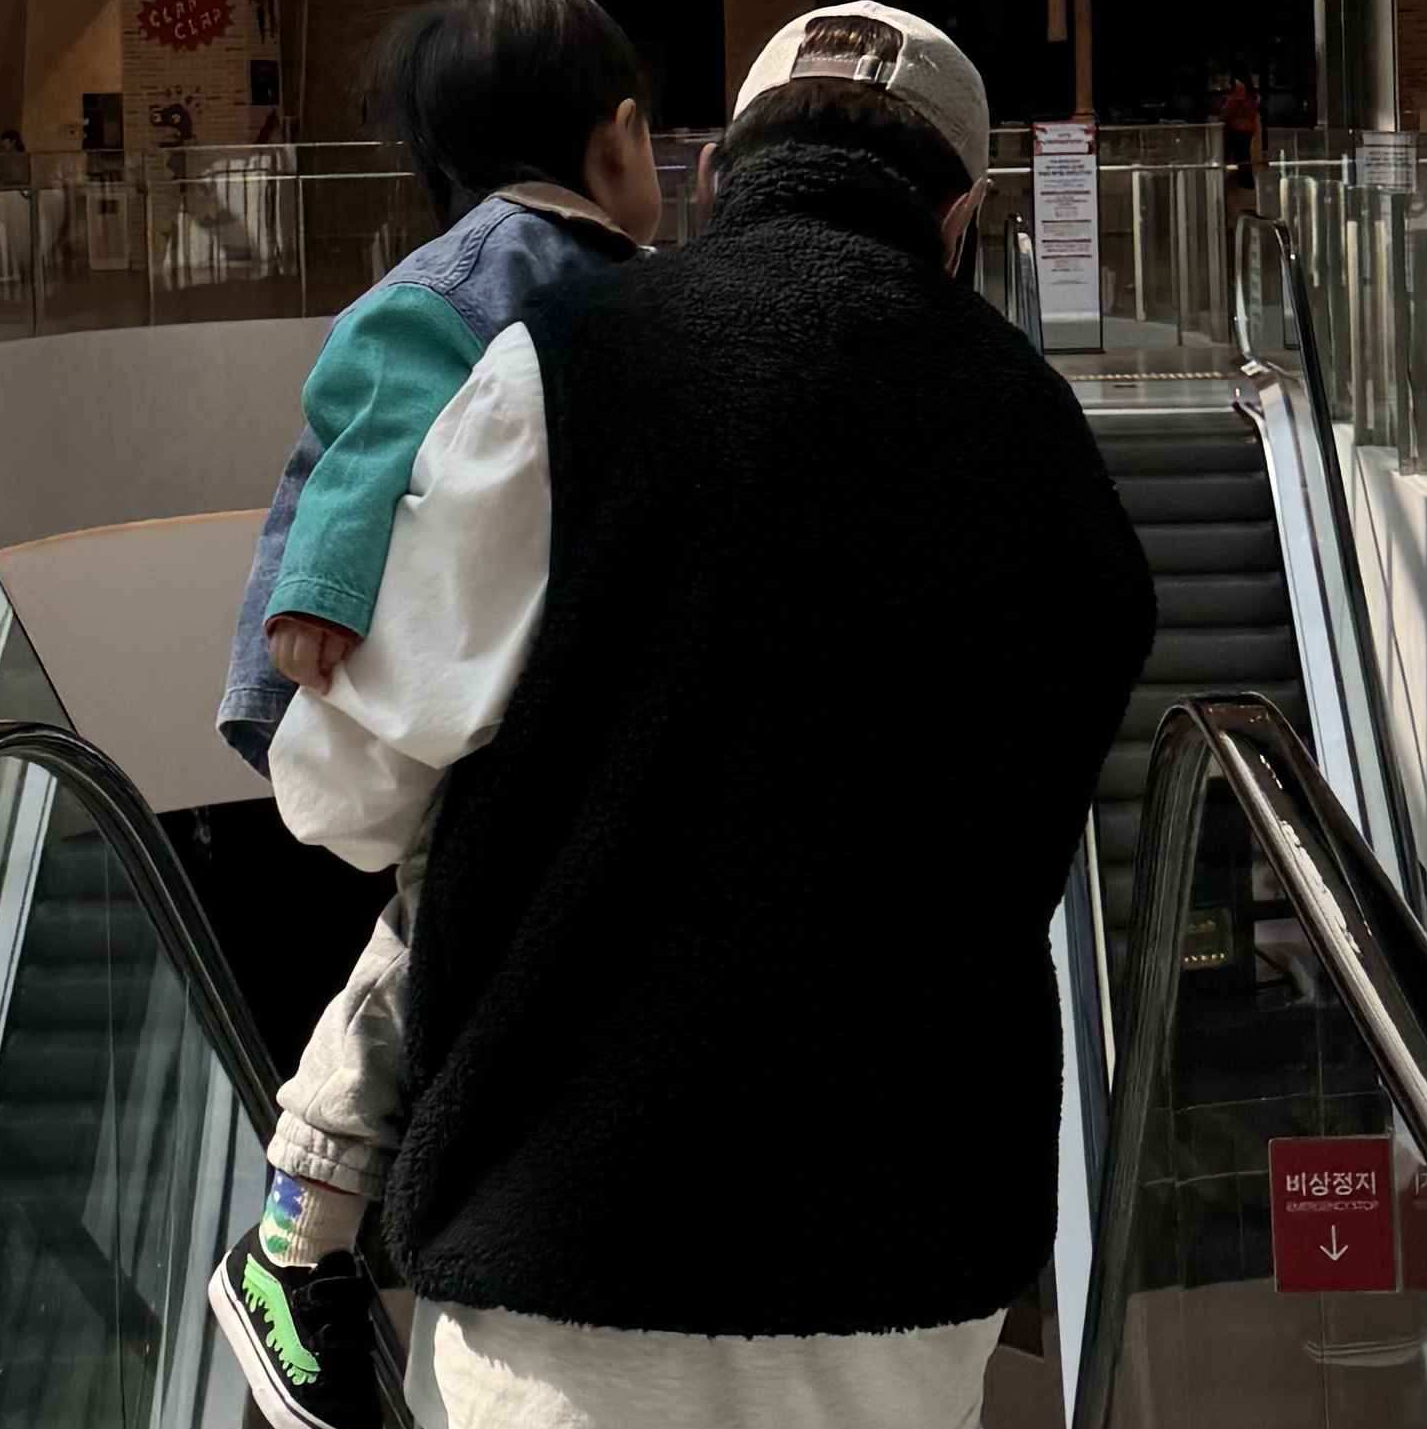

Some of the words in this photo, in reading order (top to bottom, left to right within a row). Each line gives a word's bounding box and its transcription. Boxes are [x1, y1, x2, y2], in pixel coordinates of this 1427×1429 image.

[149, 0, 197, 28] CLAP
[174, 8, 222, 40] CLAP
[1286, 1171, 1376, 1196] 비상정지
